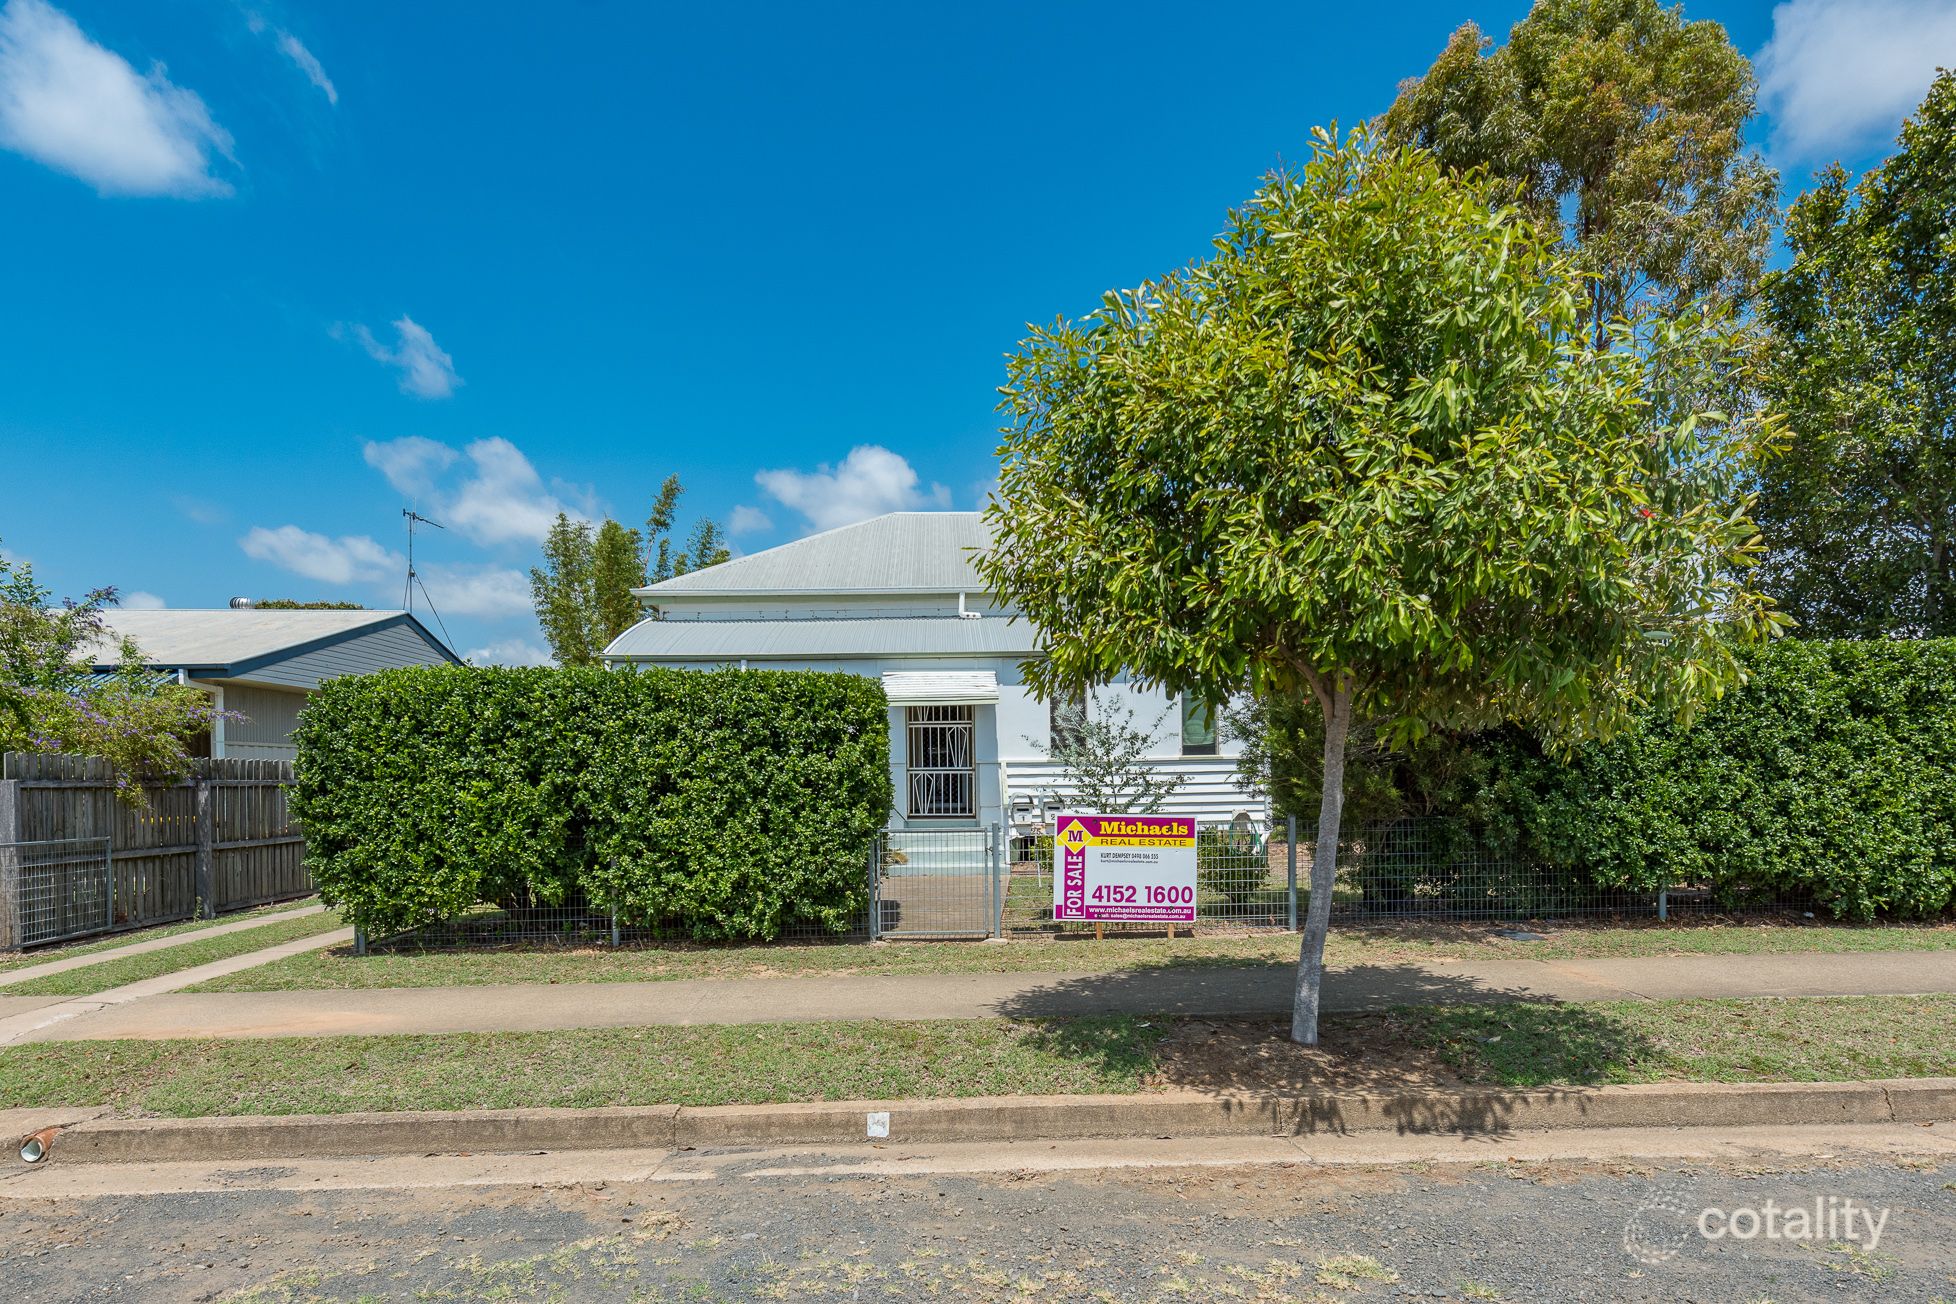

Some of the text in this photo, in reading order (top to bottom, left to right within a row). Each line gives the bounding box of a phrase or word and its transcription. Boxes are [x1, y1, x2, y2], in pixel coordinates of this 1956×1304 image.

[1099, 821, 1188, 835] Michaels
[1068, 830, 1083, 842] M
[1100, 838, 1187, 847] REAL ESTATE
[1066, 855, 1083, 915] FOR SALE
[1091, 885, 1193, 904] 4152 1600
[1088, 906, 1192, 914] www.michaelsrealestate.com.au
